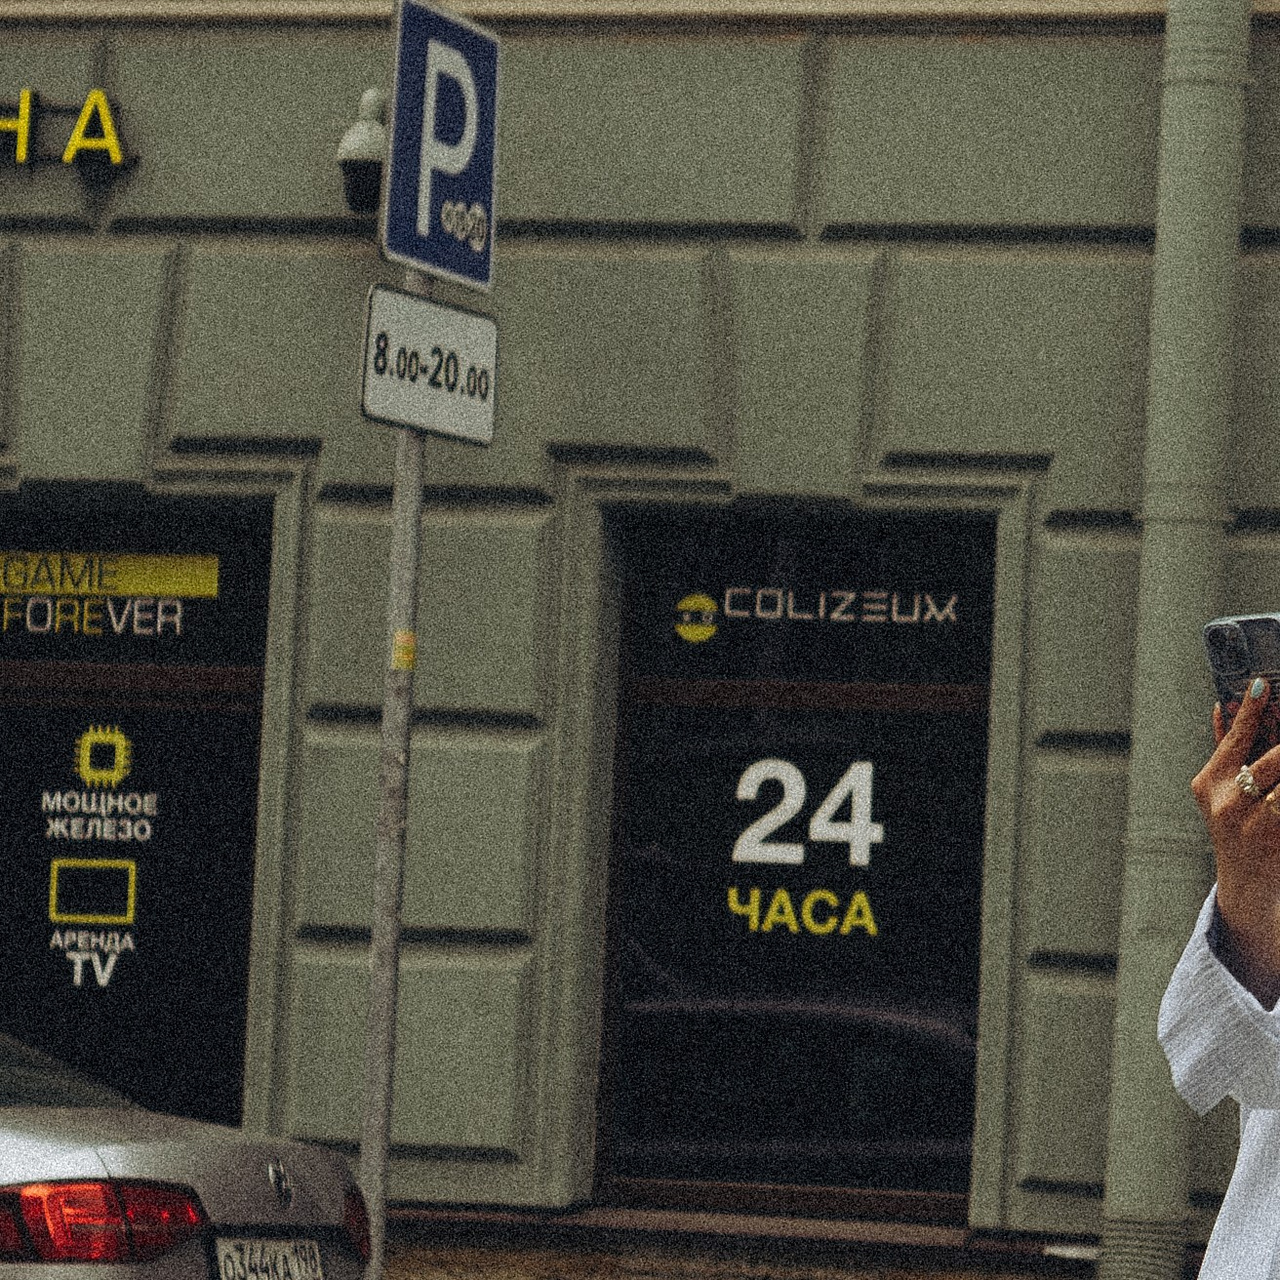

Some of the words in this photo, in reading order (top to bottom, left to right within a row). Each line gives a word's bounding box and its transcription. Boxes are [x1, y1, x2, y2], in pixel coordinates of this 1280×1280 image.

[416, 39, 480, 238] P
[372, 332, 490, 402] 8.00-20.00
[2, 554, 119, 592] GAME
[2, 596, 184, 636] FOREVER
[723, 586, 959, 624] COLIZEUM
[41, 791, 158, 816] МОЩНОЕ
[732, 758, 885, 867] 24
[45, 817, 152, 842] ЖЕЛЕЗО
[727, 887, 878, 937] ЧАСА
[49, 929, 135, 952] АРЕНДА
[65, 951, 120, 987] TV
